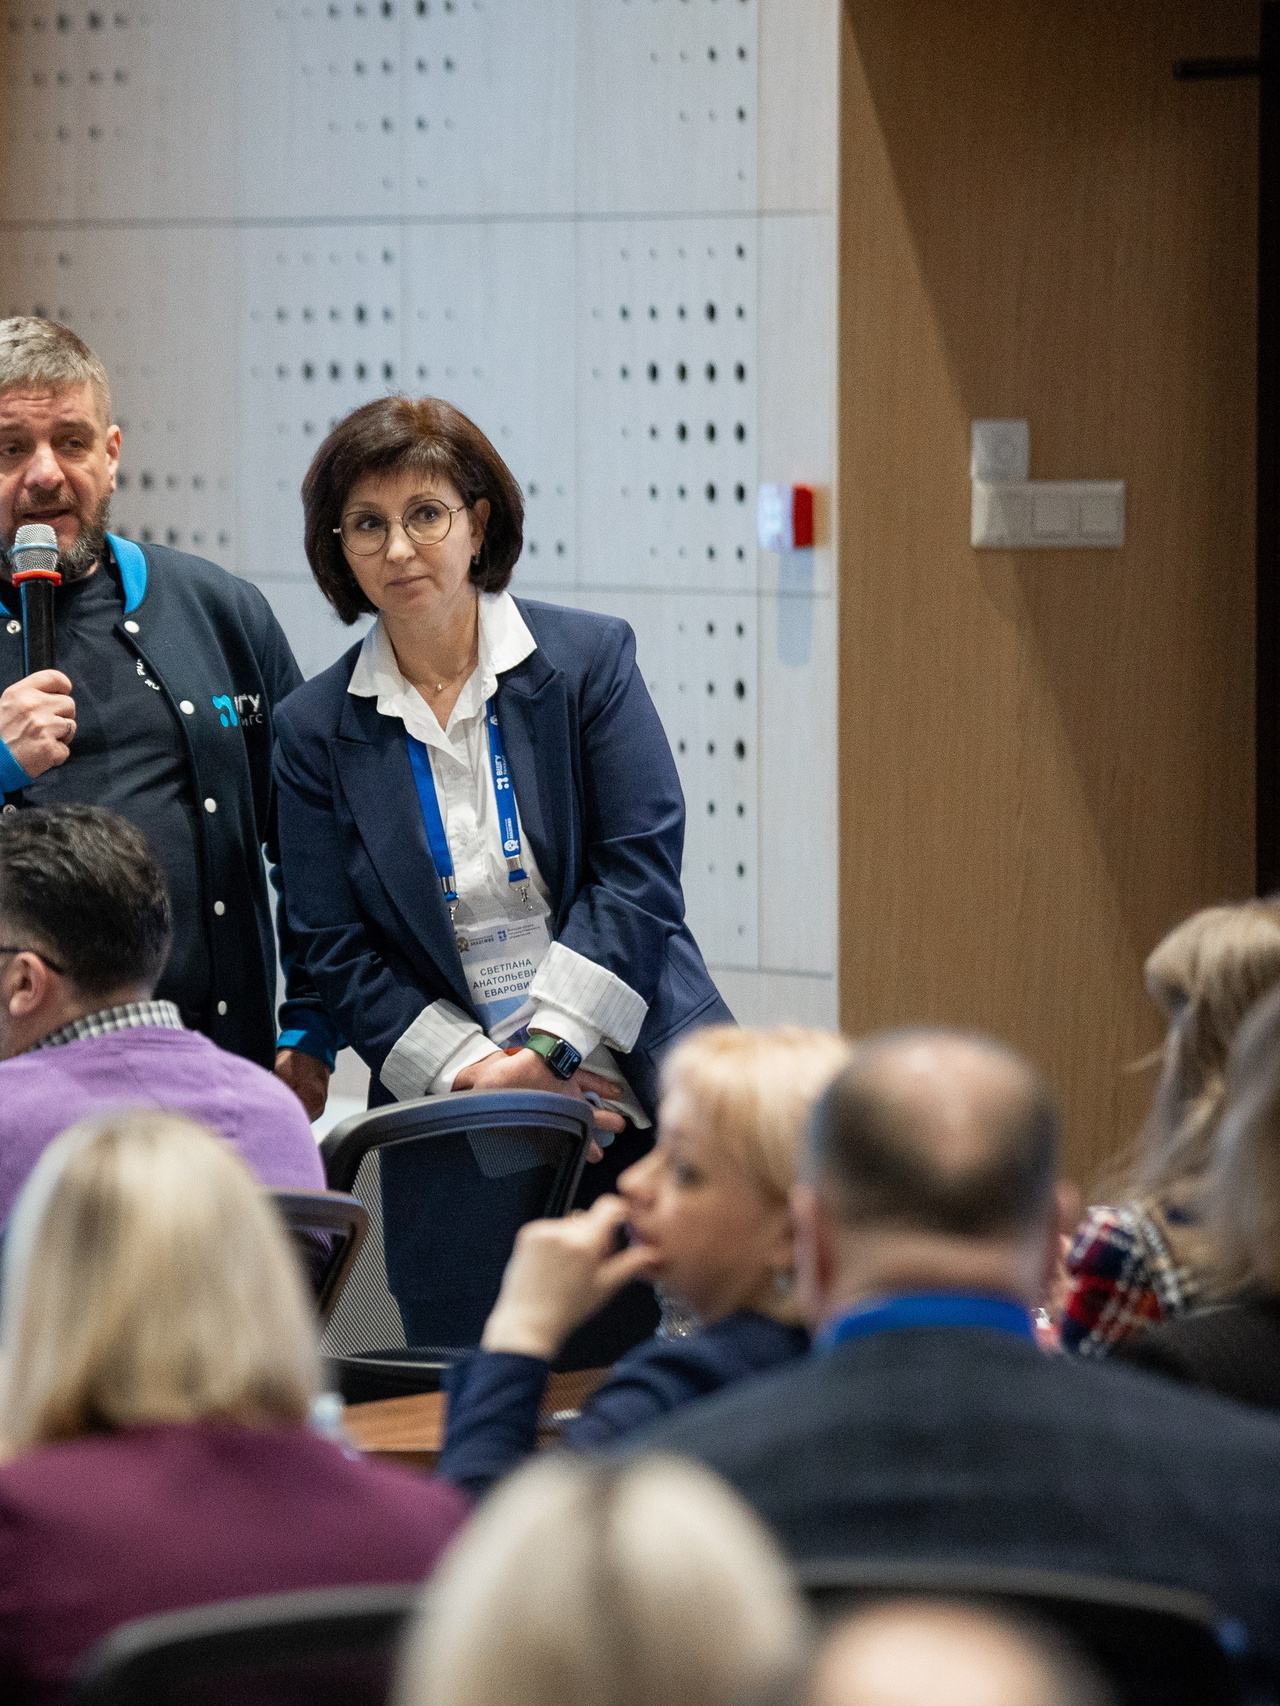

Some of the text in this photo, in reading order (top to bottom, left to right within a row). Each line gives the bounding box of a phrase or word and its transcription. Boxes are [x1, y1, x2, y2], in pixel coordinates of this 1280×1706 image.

[480, 958, 532, 976] СВЕТЛАНА
[473, 968, 537, 989] АНАТОЛЬЕВН
[484, 981, 533, 998] ЕВАРОВИ
